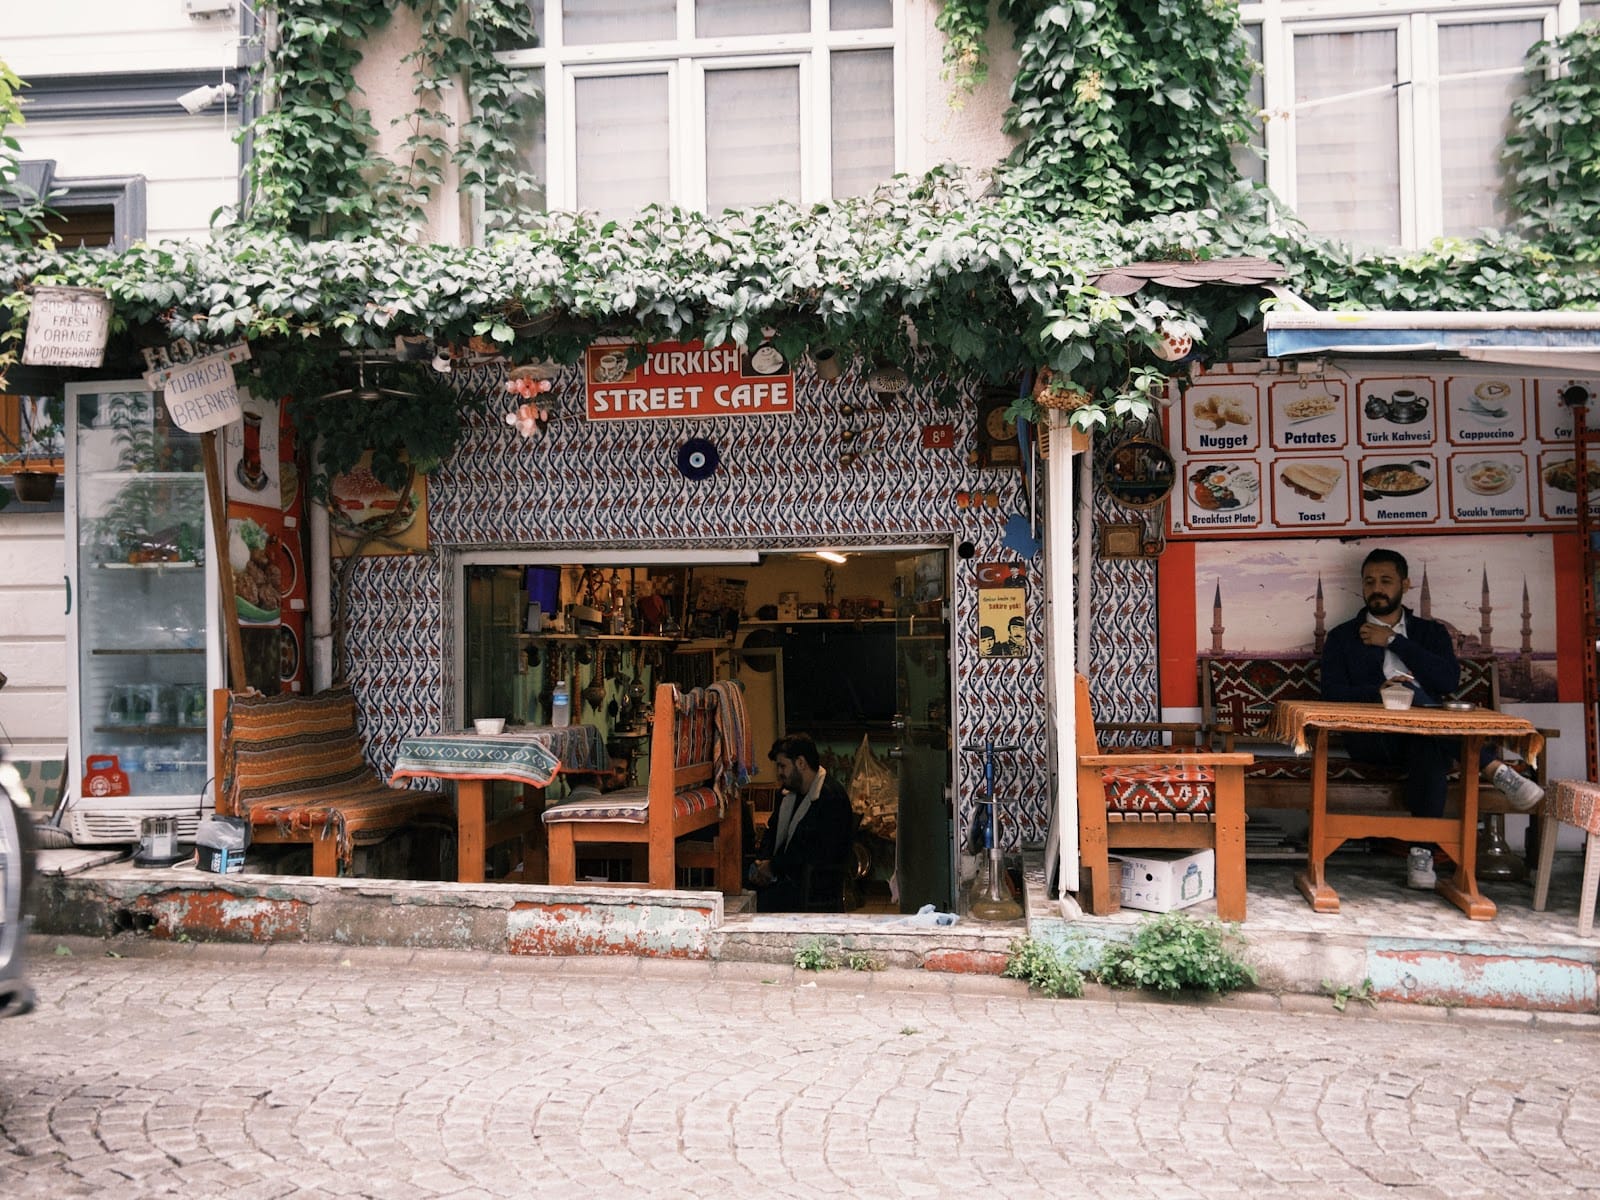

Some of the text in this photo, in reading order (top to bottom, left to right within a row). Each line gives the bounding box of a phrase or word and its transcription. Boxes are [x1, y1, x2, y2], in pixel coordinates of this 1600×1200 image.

[53, 315, 89, 327] FRESH
[43, 329, 93, 342] ORANGE
[643, 350, 739, 376] TURKISH
[168, 362, 228, 394] TURKISH
[593, 382, 788, 413] STREET CAFE
[1284, 431, 1337, 445] Patates
[1366, 430, 1432, 442] Türk Kahvesi
[1459, 428, 1515, 440] Cappuccino
[1554, 427, 1572, 440] Çay
[1199, 434, 1248, 449] Nugget
[1298, 511, 1326, 521] Toast
[1377, 510, 1428, 520] Menemen
[1457, 507, 1525, 518] Sucuklu Yumurta
[1192, 513, 1256, 525] Breakfast Plate
